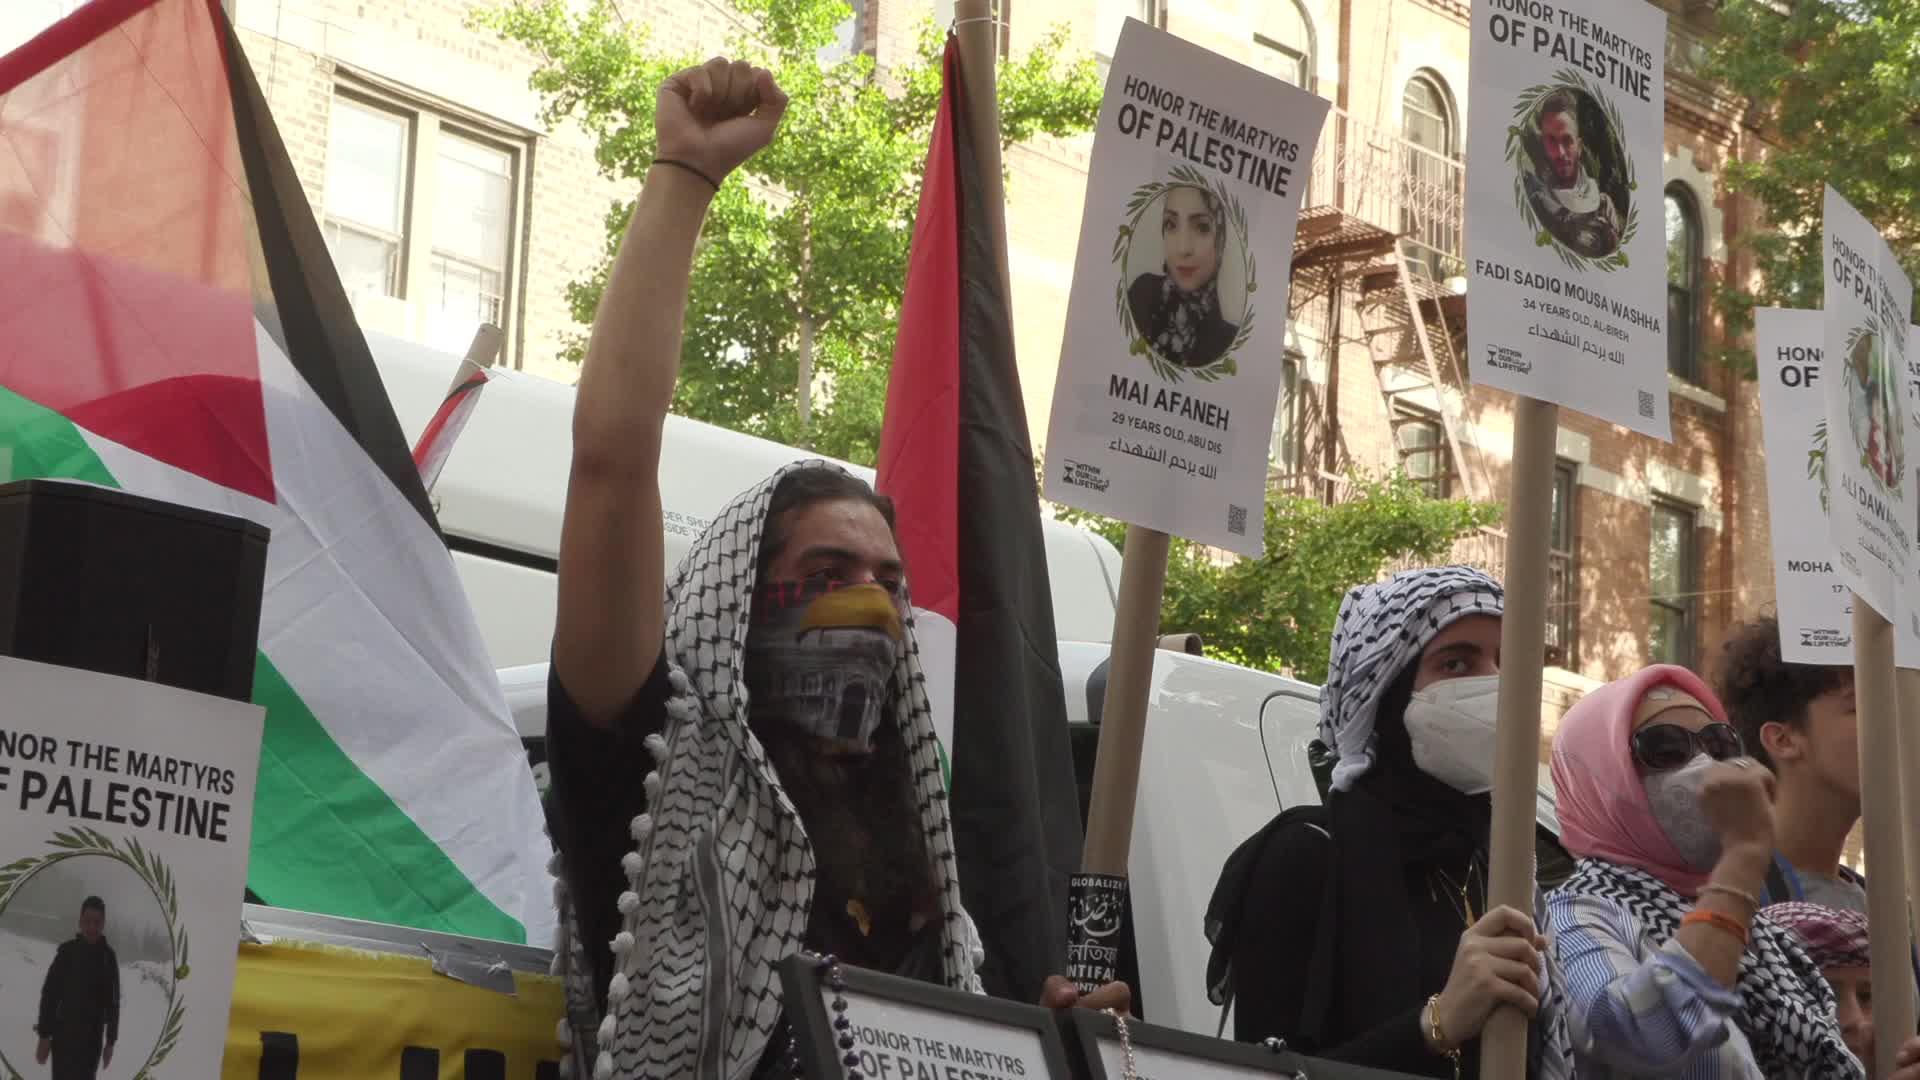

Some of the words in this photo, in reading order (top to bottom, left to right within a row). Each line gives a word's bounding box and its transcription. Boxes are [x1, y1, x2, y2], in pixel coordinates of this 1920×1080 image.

[1559, 9, 1589, 37] THE
[1592, 23, 1652, 70] MARTYRS
[1489, 14, 1526, 47] OF
[1533, 26, 1651, 102] PALESTINE
[1123, 74, 1185, 117] HONOR
[1188, 100, 1220, 131] THE
[1220, 116, 1299, 163] MARTYRS
[1118, 103, 1154, 140] OF
[1156, 118, 1292, 198] PALESTINE
[1832, 234, 1865, 275] HONOR
[1833, 258, 1851, 289] OF
[1476, 259, 1510, 281] FADI
[1514, 269, 1561, 294] SADIQ
[1565, 282, 1608, 312] MOUSA
[1611, 300, 1661, 334] WASHHA
[1522, 298, 1536, 310] 34
[1539, 302, 1571, 320] YEARS
[1528, 323, 1580, 349] الشهداء
[1583, 339, 1607, 363] يرحم
[1608, 349, 1625, 366] الله
[1777, 346, 1824, 362] HON
[1780, 365, 1819, 388] OF
[1109, 374, 1148, 406] MAI
[1153, 388, 1230, 431] AFANEH
[1112, 411, 1125, 424] 29
[1128, 415, 1161, 435] YEARS
[1187, 433, 1206, 449] ABU
[1208, 441, 1222, 454] DIS
[1108, 437, 1167, 464] الشهداء
[1169, 454, 1198, 477] يرحم
[1199, 463, 1217, 480] الله
[0, 730, 57, 765] NOR
[66, 740, 120, 774] THE
[126, 750, 235, 795] MARTYRS
[19, 769, 231, 843] PALESTINE
[1066, 964, 1116, 981] INTIFA
[850, 1024, 911, 1053] HONOR
[913, 1037, 947, 1060] THE
[948, 1044, 1025, 1076] MARTYRS
[859, 1050, 892, 1080] OF
